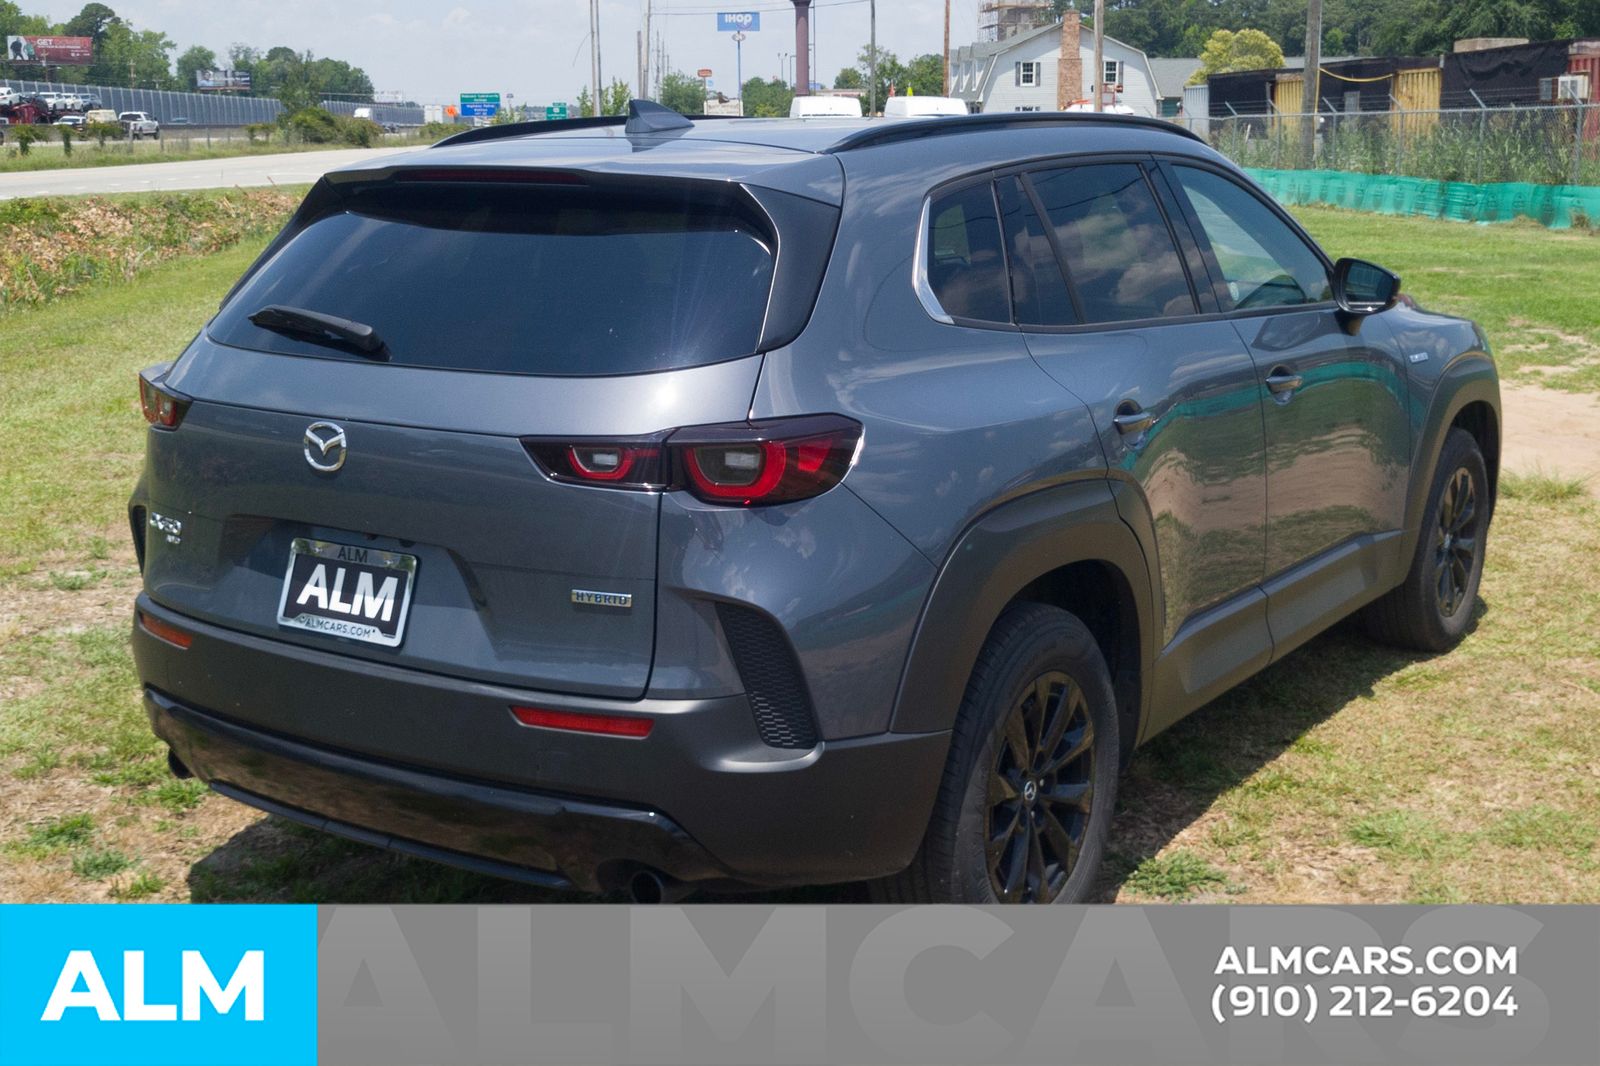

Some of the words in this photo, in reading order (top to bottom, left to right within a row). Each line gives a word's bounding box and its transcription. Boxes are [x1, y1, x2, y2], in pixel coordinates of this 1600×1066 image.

[337, 546, 368, 563] ALM
[296, 563, 399, 622] ALM
[575, 591, 627, 605] HYBRID
